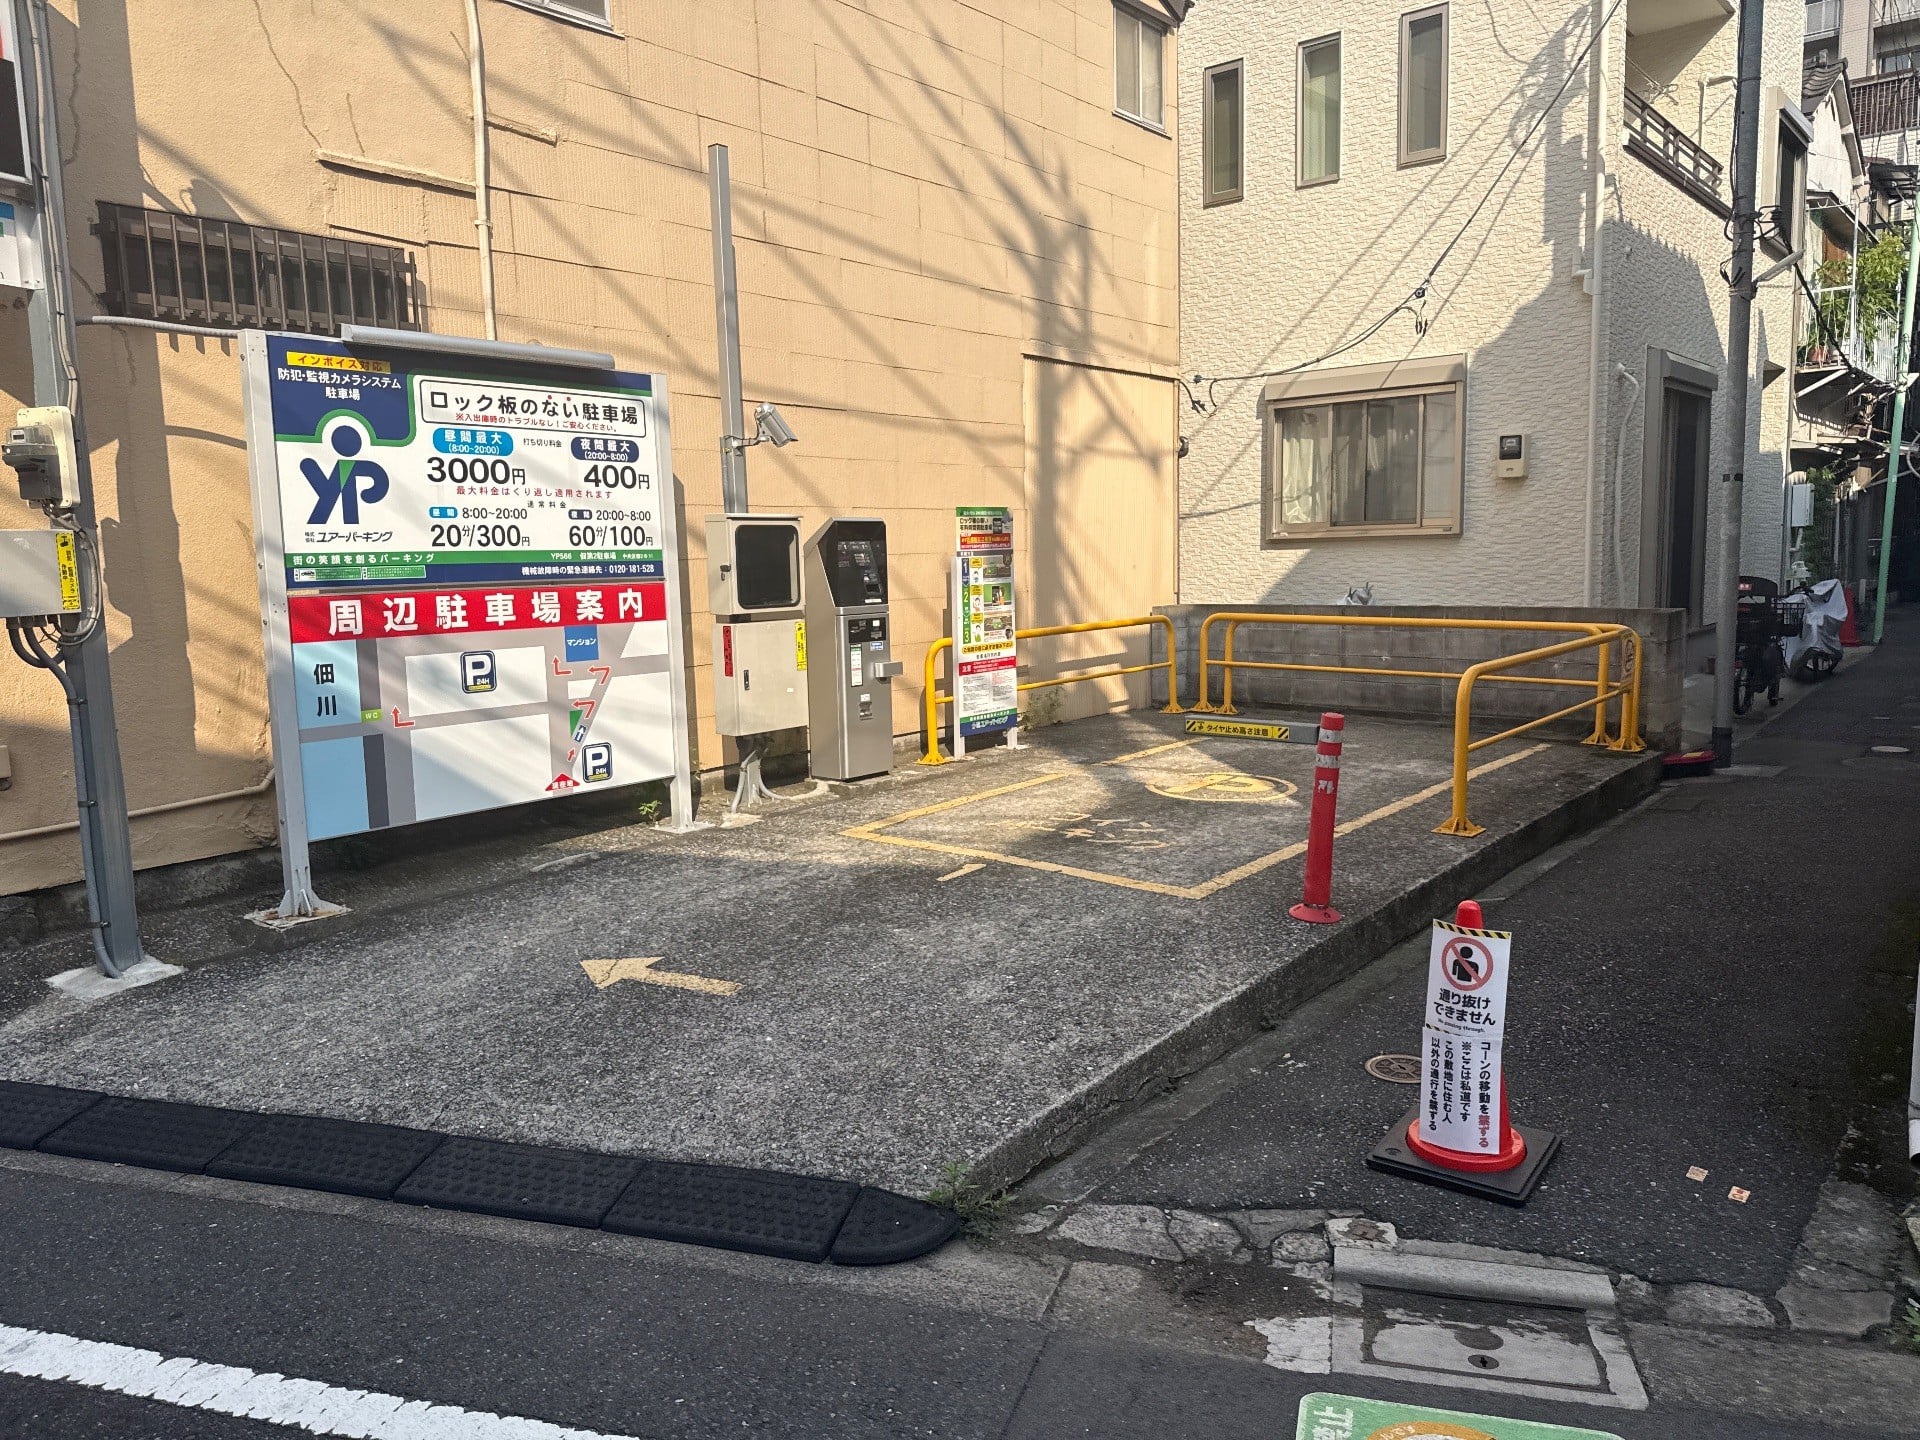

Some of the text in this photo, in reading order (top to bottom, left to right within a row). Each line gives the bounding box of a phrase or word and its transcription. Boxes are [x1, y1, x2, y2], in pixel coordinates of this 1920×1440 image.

[298, 355, 382, 371] インボイス対応
[278, 367, 401, 389] 防犯・監視カメラシステム
[325, 387, 361, 400] 駐車場
[431, 391, 638, 425] ロック板のない駐車場
[444, 430, 503, 445] 昼間最大
[523, 438, 562, 448] 打ち切り料金
[580, 439, 630, 453] 夜間最大
[426, 457, 526, 485] 3000円
[583, 464, 650, 490] 400円
[456, 487, 612, 500] 最大料金はくり返し適用されます
[527, 501, 567, 509] 通常料金
[293, 553, 435, 565] 街の笑顔を創るパーキング
[328, 588, 644, 637] 周辺駐車場案内
[566, 637, 596, 647] マンション
[464, 654, 492, 686] P
[365, 711, 378, 720] WC
[1206, 724, 1269, 737] タイヤ止め高さ注意
[585, 746, 609, 776] P
[1438, 987, 1491, 1010] 通り抜け
[1433, 1001, 1496, 1026] できません
[1442, 1040, 1454, 1124] この敷地に住む人
